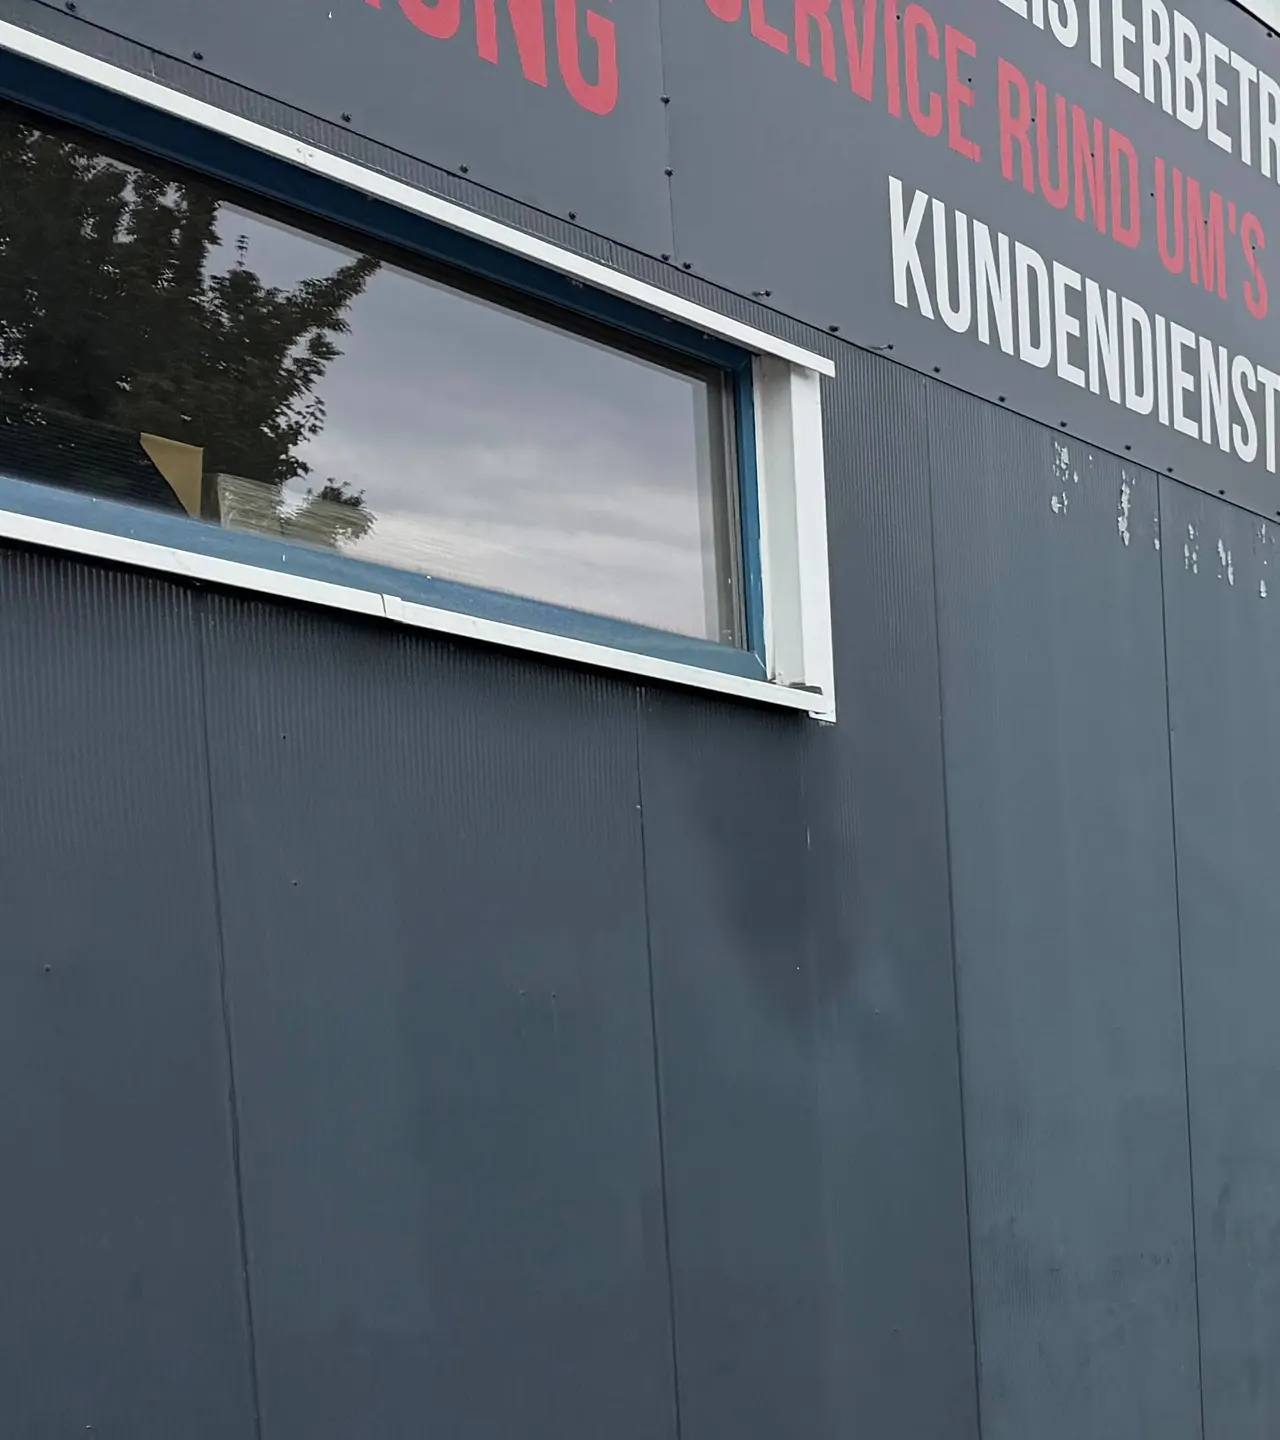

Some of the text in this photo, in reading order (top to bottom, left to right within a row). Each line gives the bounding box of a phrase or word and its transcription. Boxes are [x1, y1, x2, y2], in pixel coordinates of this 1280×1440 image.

[706, 0, 981, 163] RVICE
[997, 56, 1141, 249] RUND
[1155, 157, 1268, 319] UM'S
